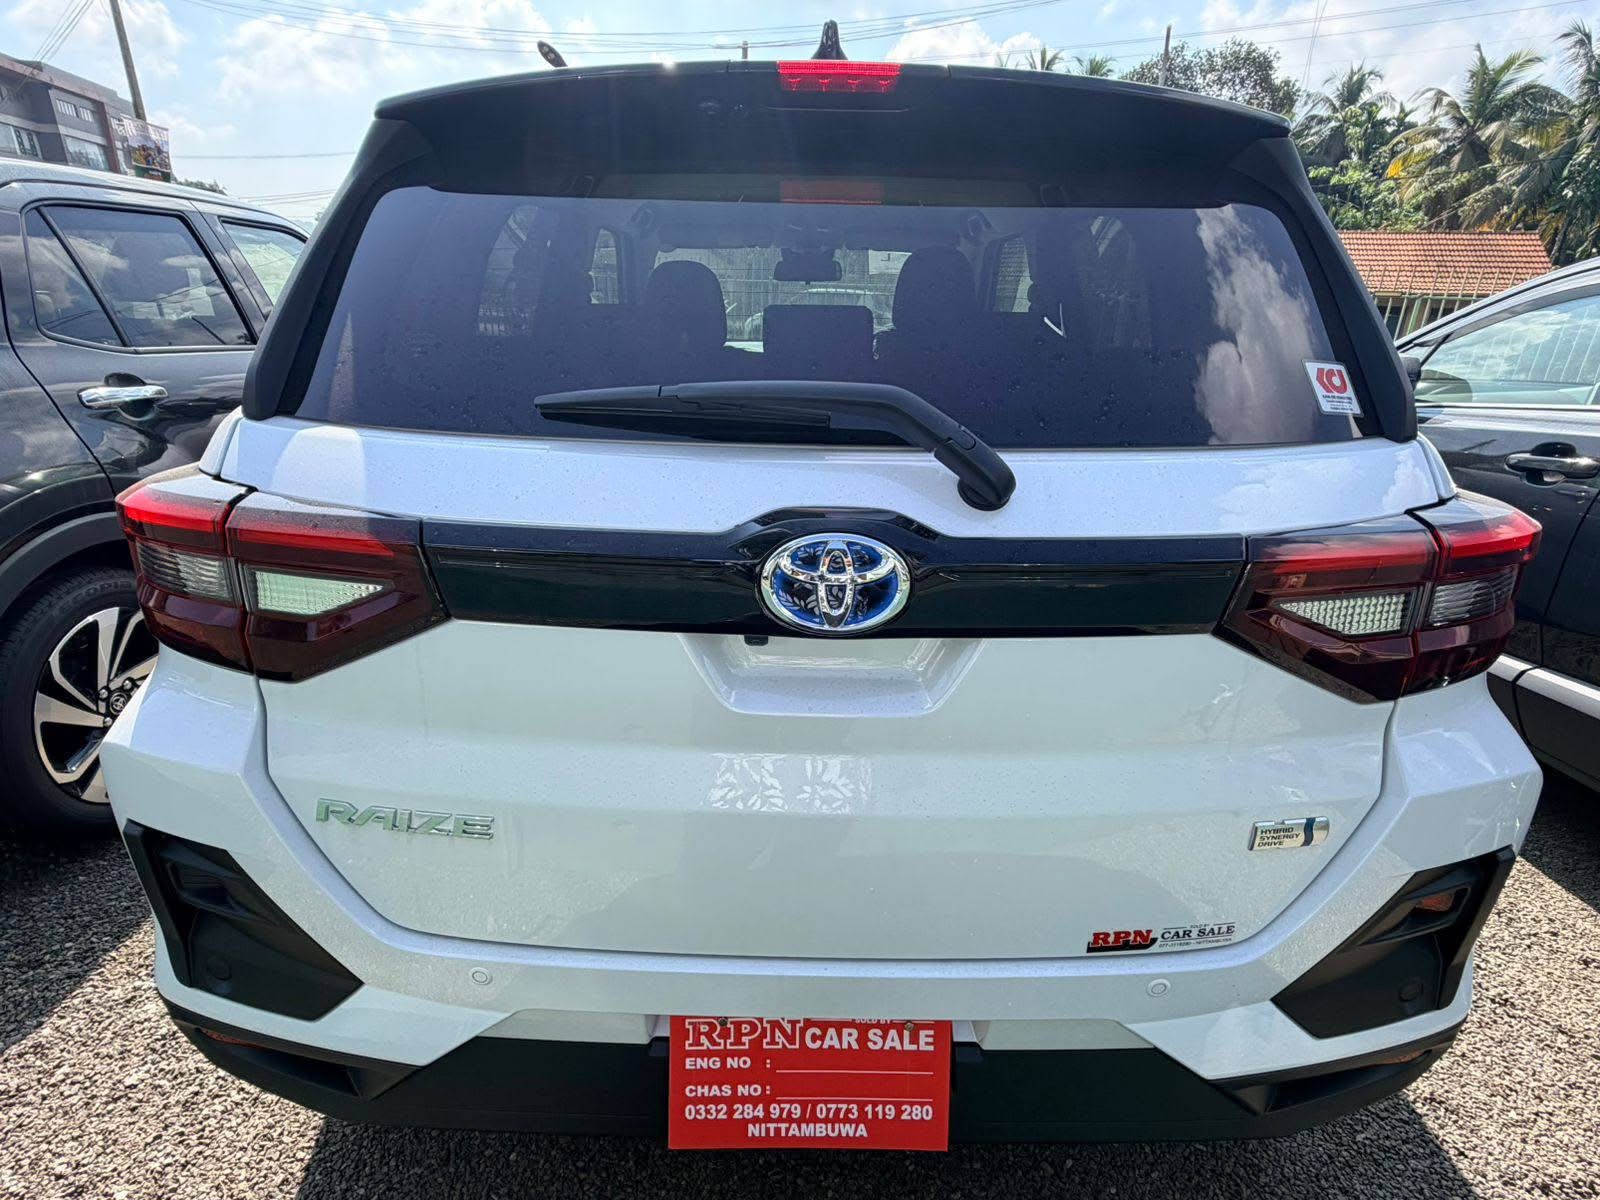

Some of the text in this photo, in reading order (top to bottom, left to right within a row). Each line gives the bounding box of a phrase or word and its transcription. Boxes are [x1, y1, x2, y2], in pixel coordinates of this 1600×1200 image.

[315, 797, 495, 840] RAIZE
[1259, 833, 1301, 841] SYNERGY
[1260, 827, 1294, 835] HYBRID
[1090, 929, 1153, 946] RPN
[1160, 925, 1235, 940] CAR SALE
[685, 1017, 934, 1050] RPN CAR SALE
[685, 1057, 721, 1069] ENG
[726, 1057, 751, 1069] NO
[685, 1085, 732, 1097] CHAS
[685, 1104, 727, 1119] 0332
[733, 1104, 765, 1119] 284
[770, 1104, 801, 1119] 979
[816, 1104, 858, 1119] 0773
[865, 1104, 895, 1119] 119
[901, 1105, 933, 1120] 280
[748, 1123, 868, 1137] NITTAMBUWA
